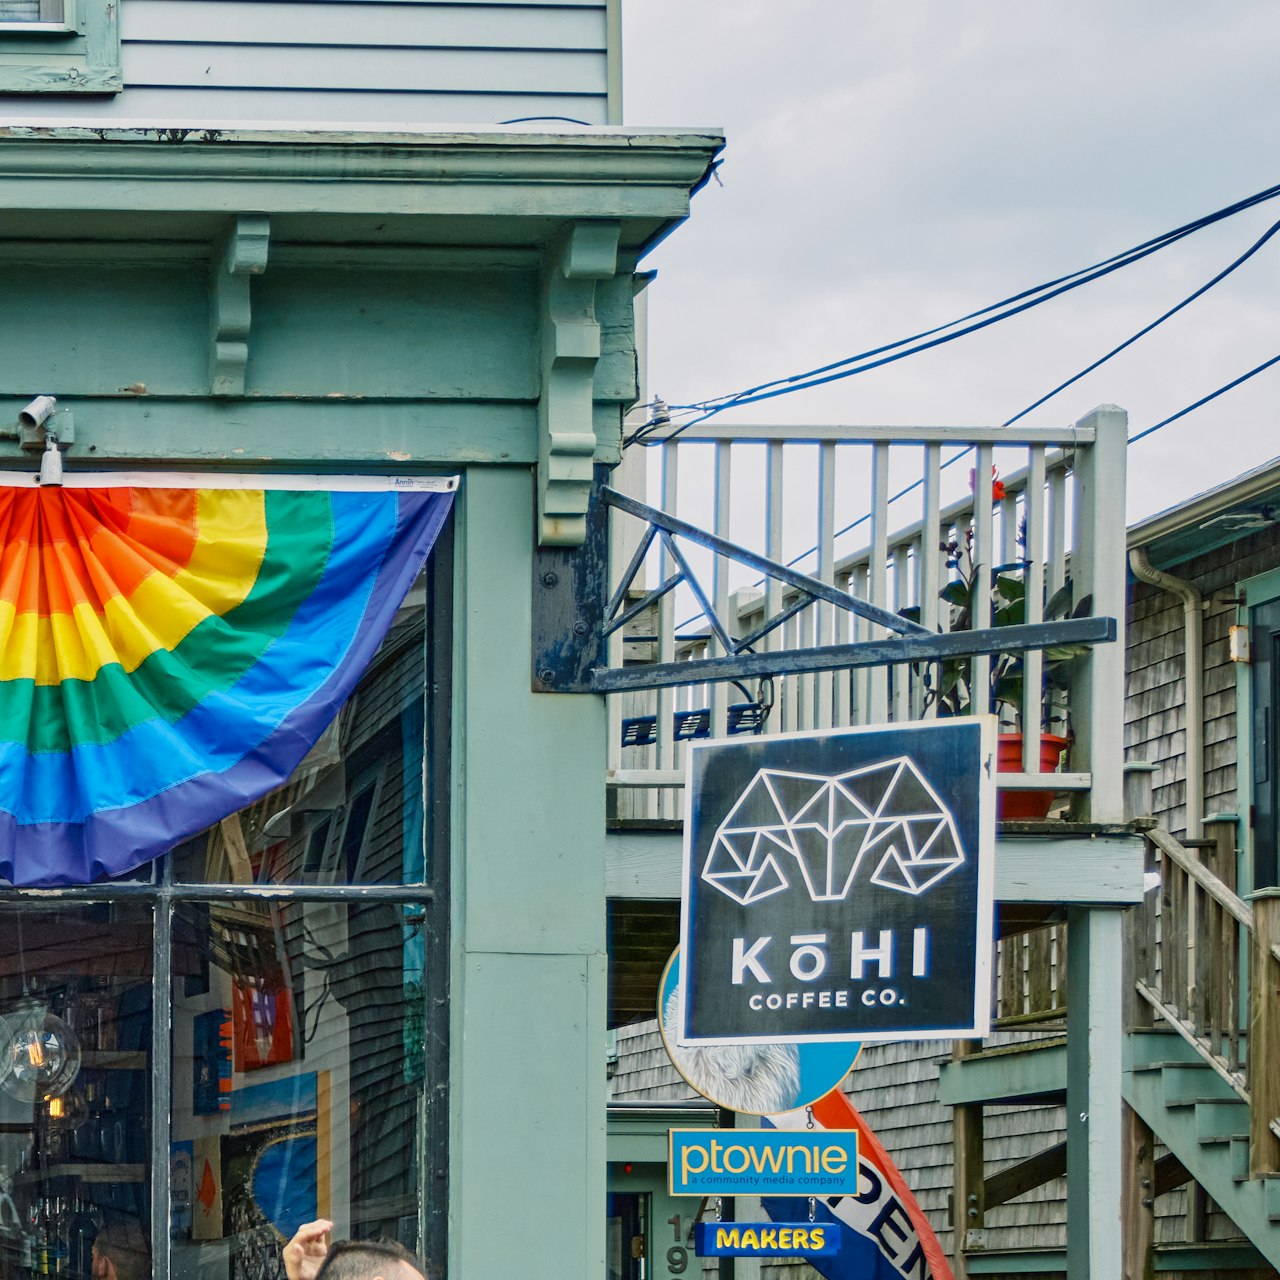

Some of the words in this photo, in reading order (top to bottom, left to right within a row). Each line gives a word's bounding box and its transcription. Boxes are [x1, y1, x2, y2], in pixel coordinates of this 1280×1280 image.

[748, 990, 849, 1011] COFFEE
[860, 989, 906, 1008] CO.
[681, 1139, 848, 1185] ptownie
[691, 1176, 697, 1184] a
[700, 1175, 760, 1186] community
[763, 1175, 794, 1184] media
[797, 1176, 846, 1186] company
[716, 1227, 825, 1250] MAKERS
